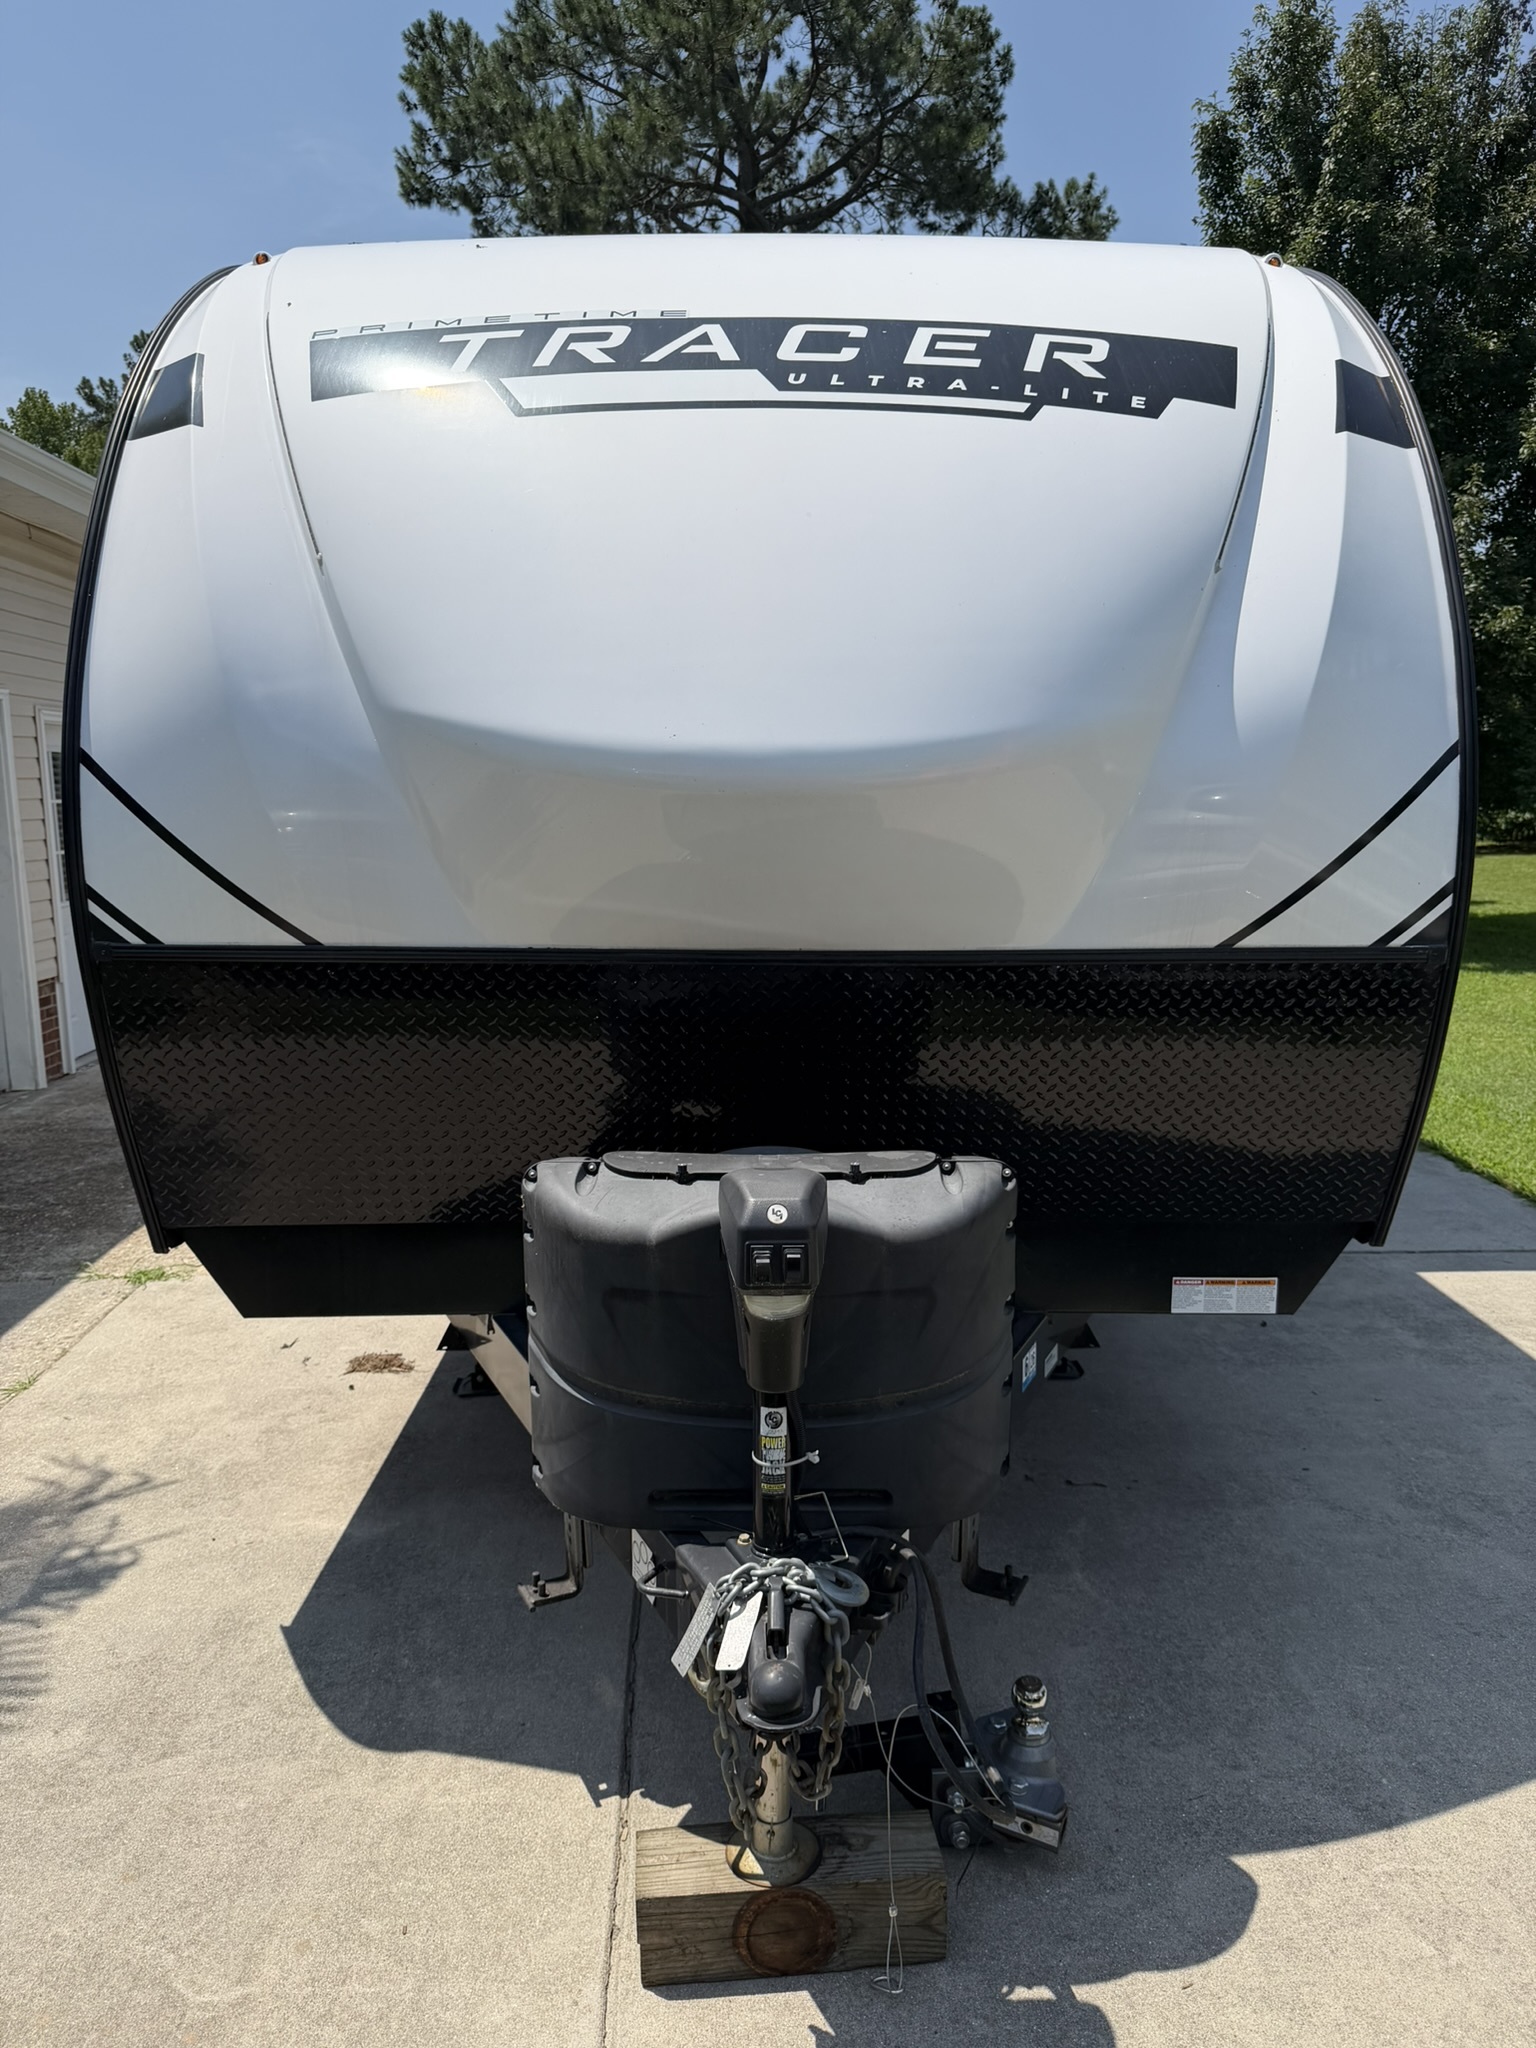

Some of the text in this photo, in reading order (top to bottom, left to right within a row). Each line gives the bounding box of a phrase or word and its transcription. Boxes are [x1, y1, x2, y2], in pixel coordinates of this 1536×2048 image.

[310, 309, 688, 340] PRIMETIME
[439, 323, 1110, 380] TRACER
[787, 373, 1146, 409] ULTRA-LITE
[761, 1436, 786, 1449] POWER
